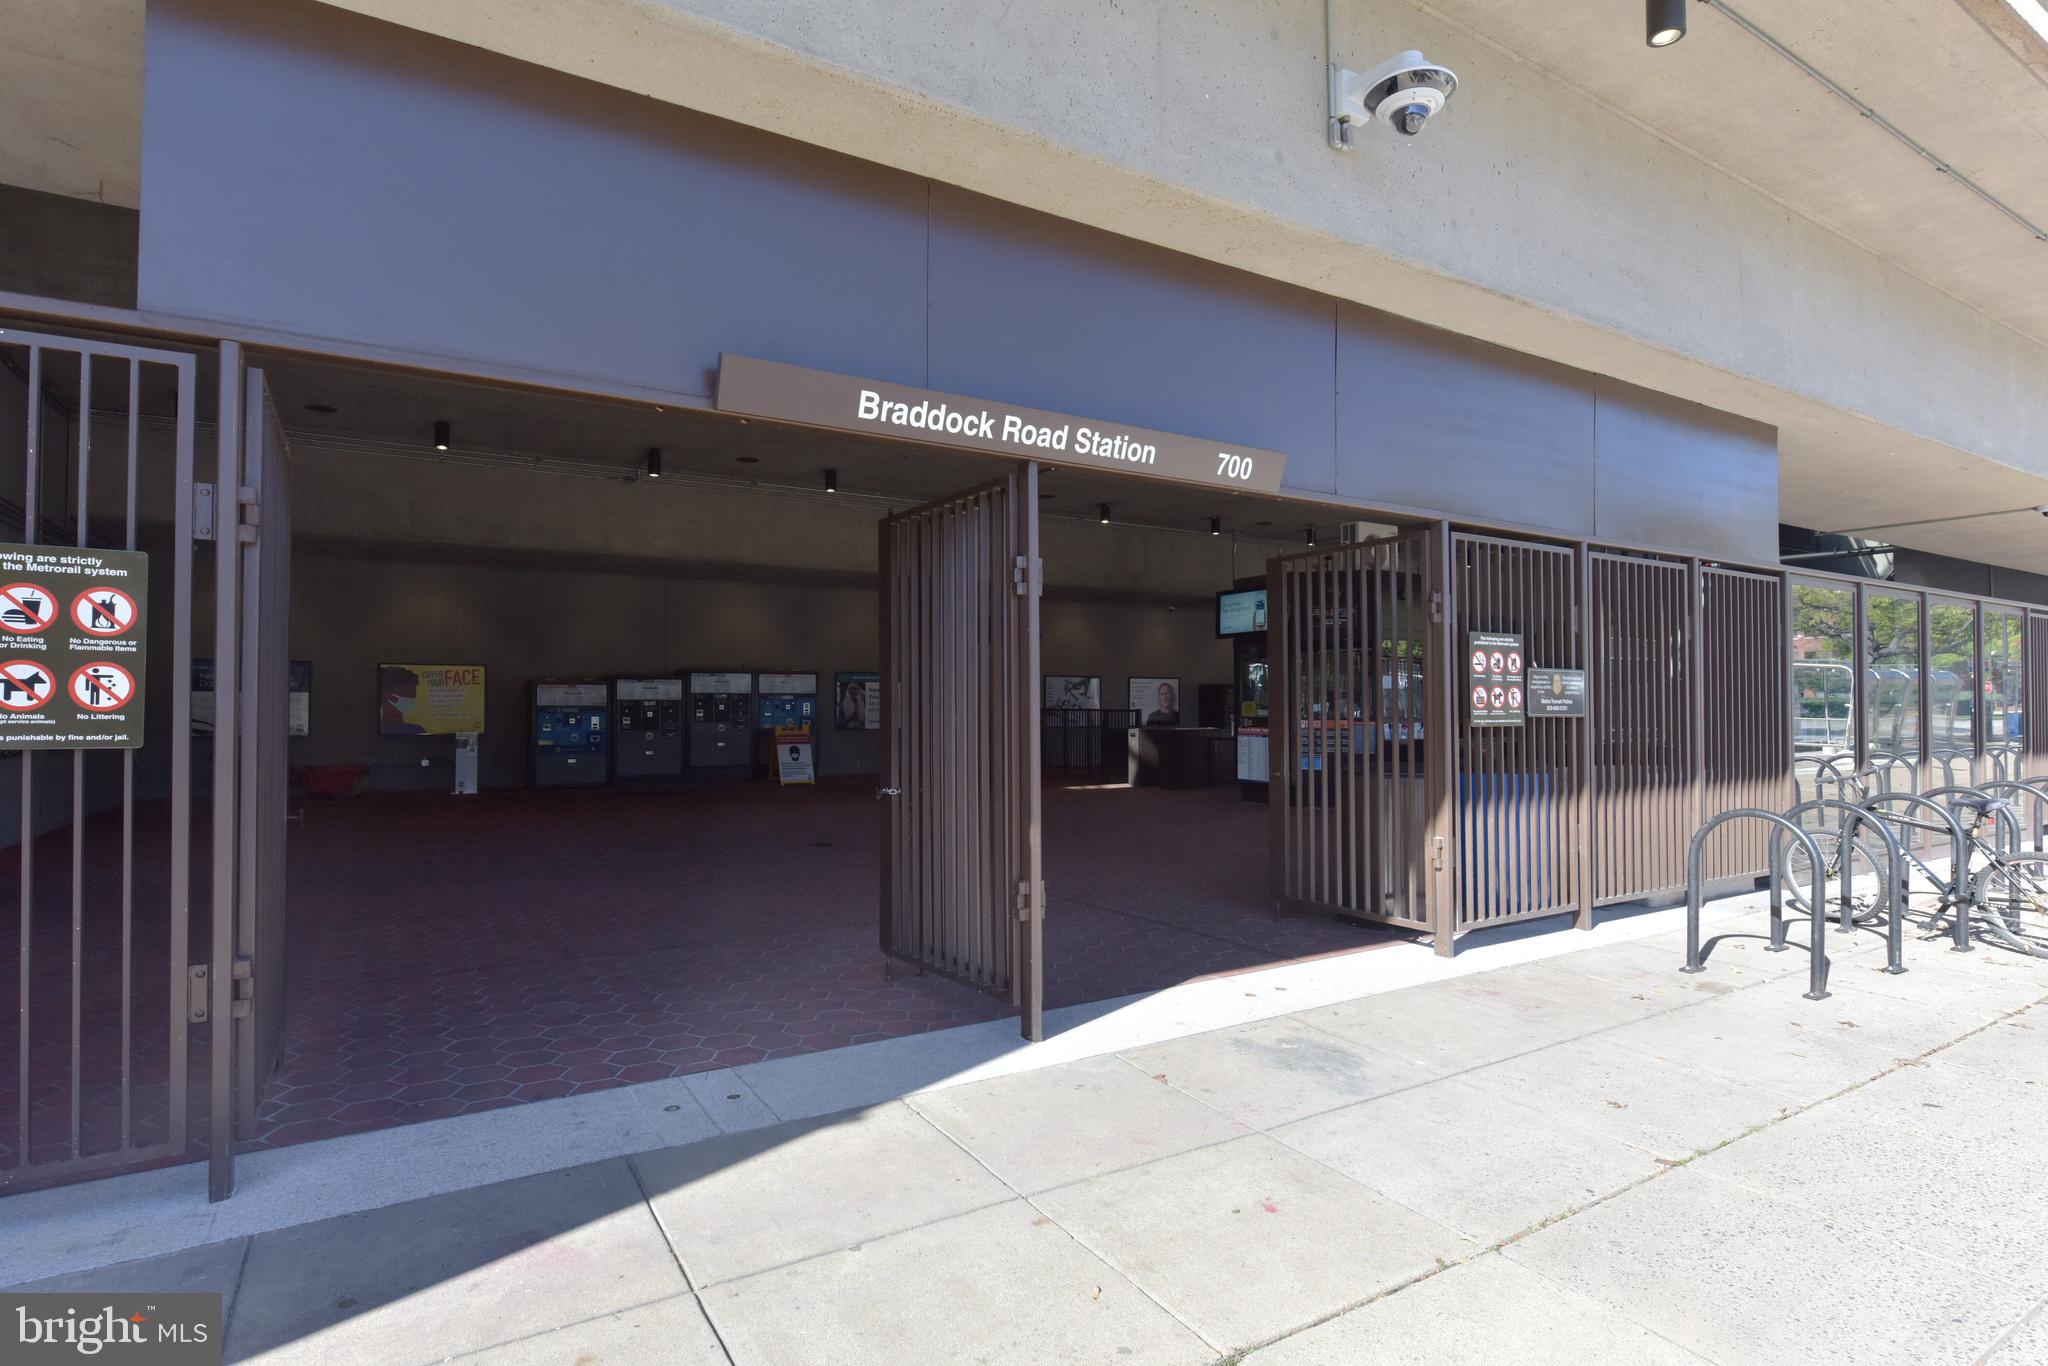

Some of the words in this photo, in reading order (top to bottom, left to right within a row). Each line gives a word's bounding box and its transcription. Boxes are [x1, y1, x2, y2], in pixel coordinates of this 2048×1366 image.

[858, 390, 996, 439] Braddock
[1002, 415, 1069, 450] Road
[1074, 428, 1156, 464] Station
[1217, 453, 1253, 480] 700
[36, 555, 57, 563] are
[60, 556, 103, 567] strictly
[2, 562, 23, 571] the
[26, 563, 81, 574] Metrorail
[84, 567, 128, 577] system
[16, 635, 44, 644] Eating
[83, 638, 127, 646] Dangerous
[10, 642, 47, 651] Drinking
[69, 644, 114, 652] Flammable
[444, 669, 481, 687] FACE
[91, 713, 125, 721] Littering
[6, 734, 54, 742] punishable
[55, 734, 66, 742] by
[114, 734, 129, 742] jail.
